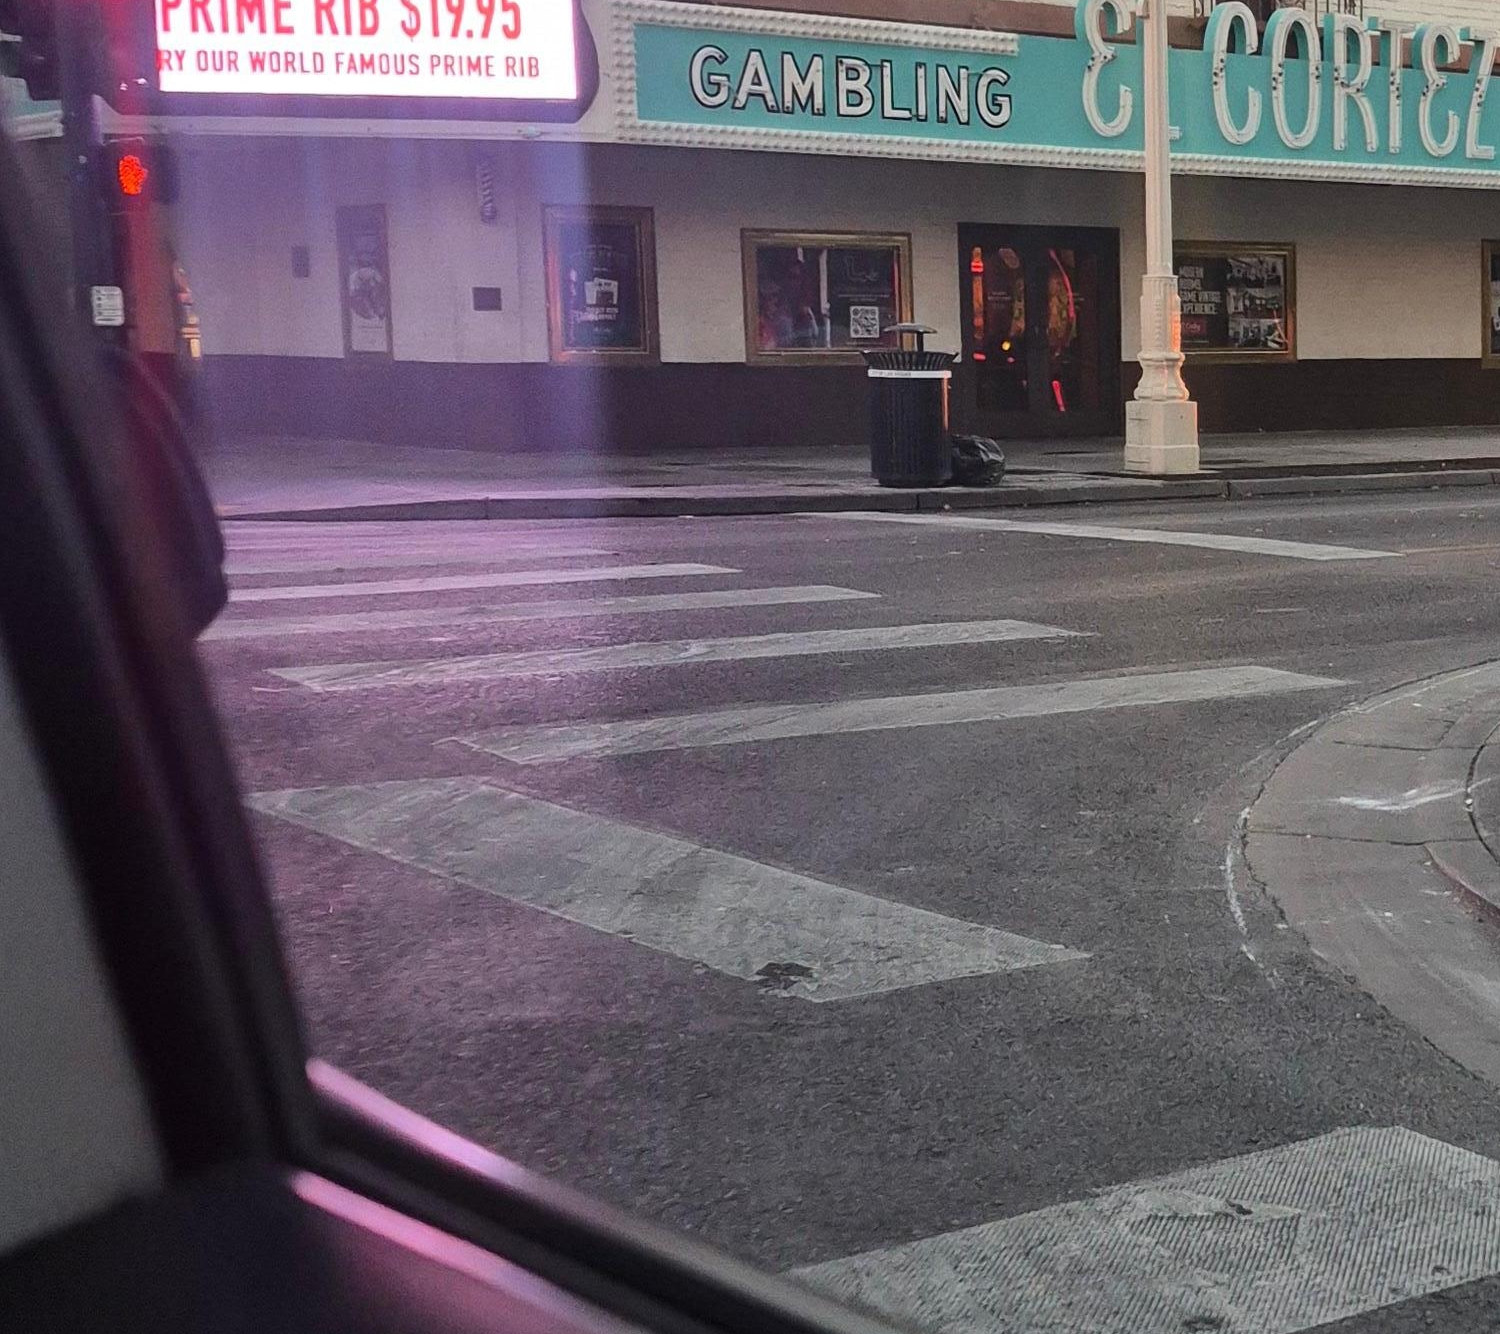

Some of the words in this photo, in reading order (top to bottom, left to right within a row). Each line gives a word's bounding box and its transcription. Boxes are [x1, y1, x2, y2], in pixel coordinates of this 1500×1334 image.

[196, 49, 240, 73] OUR
[249, 51, 325, 75] WORLD
[335, 52, 421, 76] FAMOUS
[429, 54, 496, 78] PRIME
[505, 56, 540, 78] RIB
[689, 44, 1013, 128] GAMBLING
[1204, 1, 1498, 159] CORTEZ
